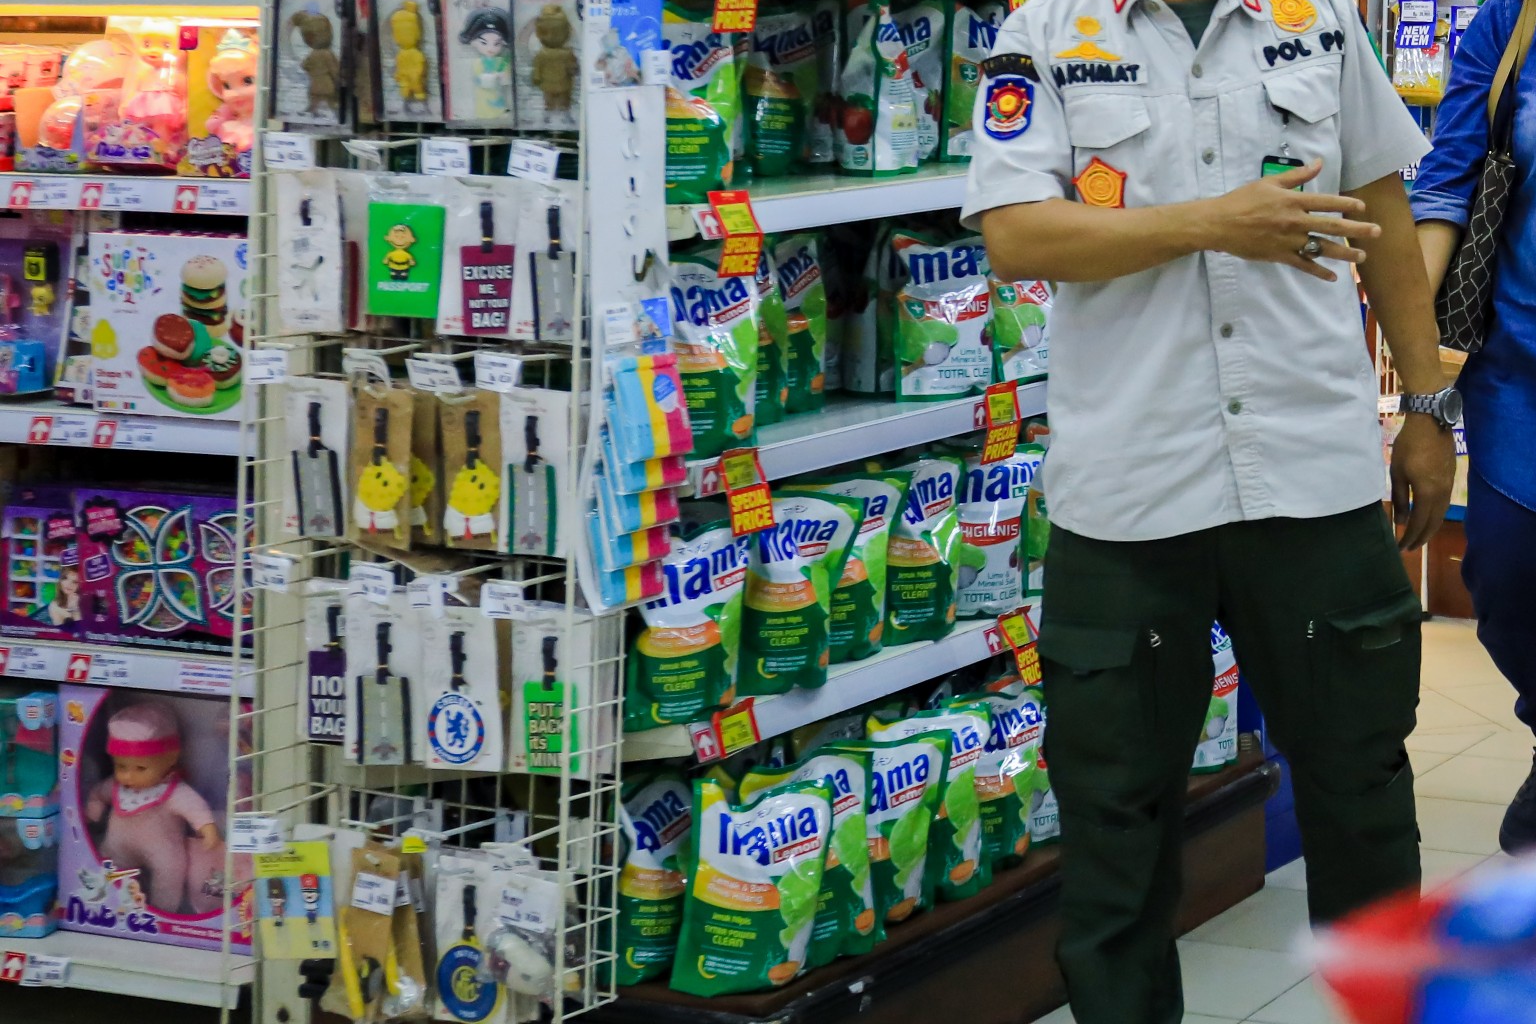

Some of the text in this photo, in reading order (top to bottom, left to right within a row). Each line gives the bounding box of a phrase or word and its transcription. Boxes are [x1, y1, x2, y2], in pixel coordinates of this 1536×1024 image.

[716, 10, 755, 30] PRICE
[1402, 25, 1430, 36] NEW
[1399, 34, 1430, 46] ITEM
[1262, 38, 1312, 67] POL
[724, 236, 760, 254] SPECIAL
[463, 265, 513, 280] EXCUSE
[721, 254, 758, 275] PRICE
[468, 298, 509, 308] NOT YOUR
[937, 368, 967, 379] TOTAL
[988, 423, 1018, 443] SPECIAL
[983, 438, 1016, 462] PRICE
[731, 488, 769, 511] SPECIAL
[733, 505, 772, 534] PRICE
[964, 593, 995, 603] TOTAL
[769, 636, 800, 647] CLEAN
[663, 681, 696, 692] CLEAN
[529, 702, 551, 717] PUT
[310, 717, 345, 736] BAG
[774, 837, 821, 865] Lemon
[712, 935, 745, 948] CLEAN
